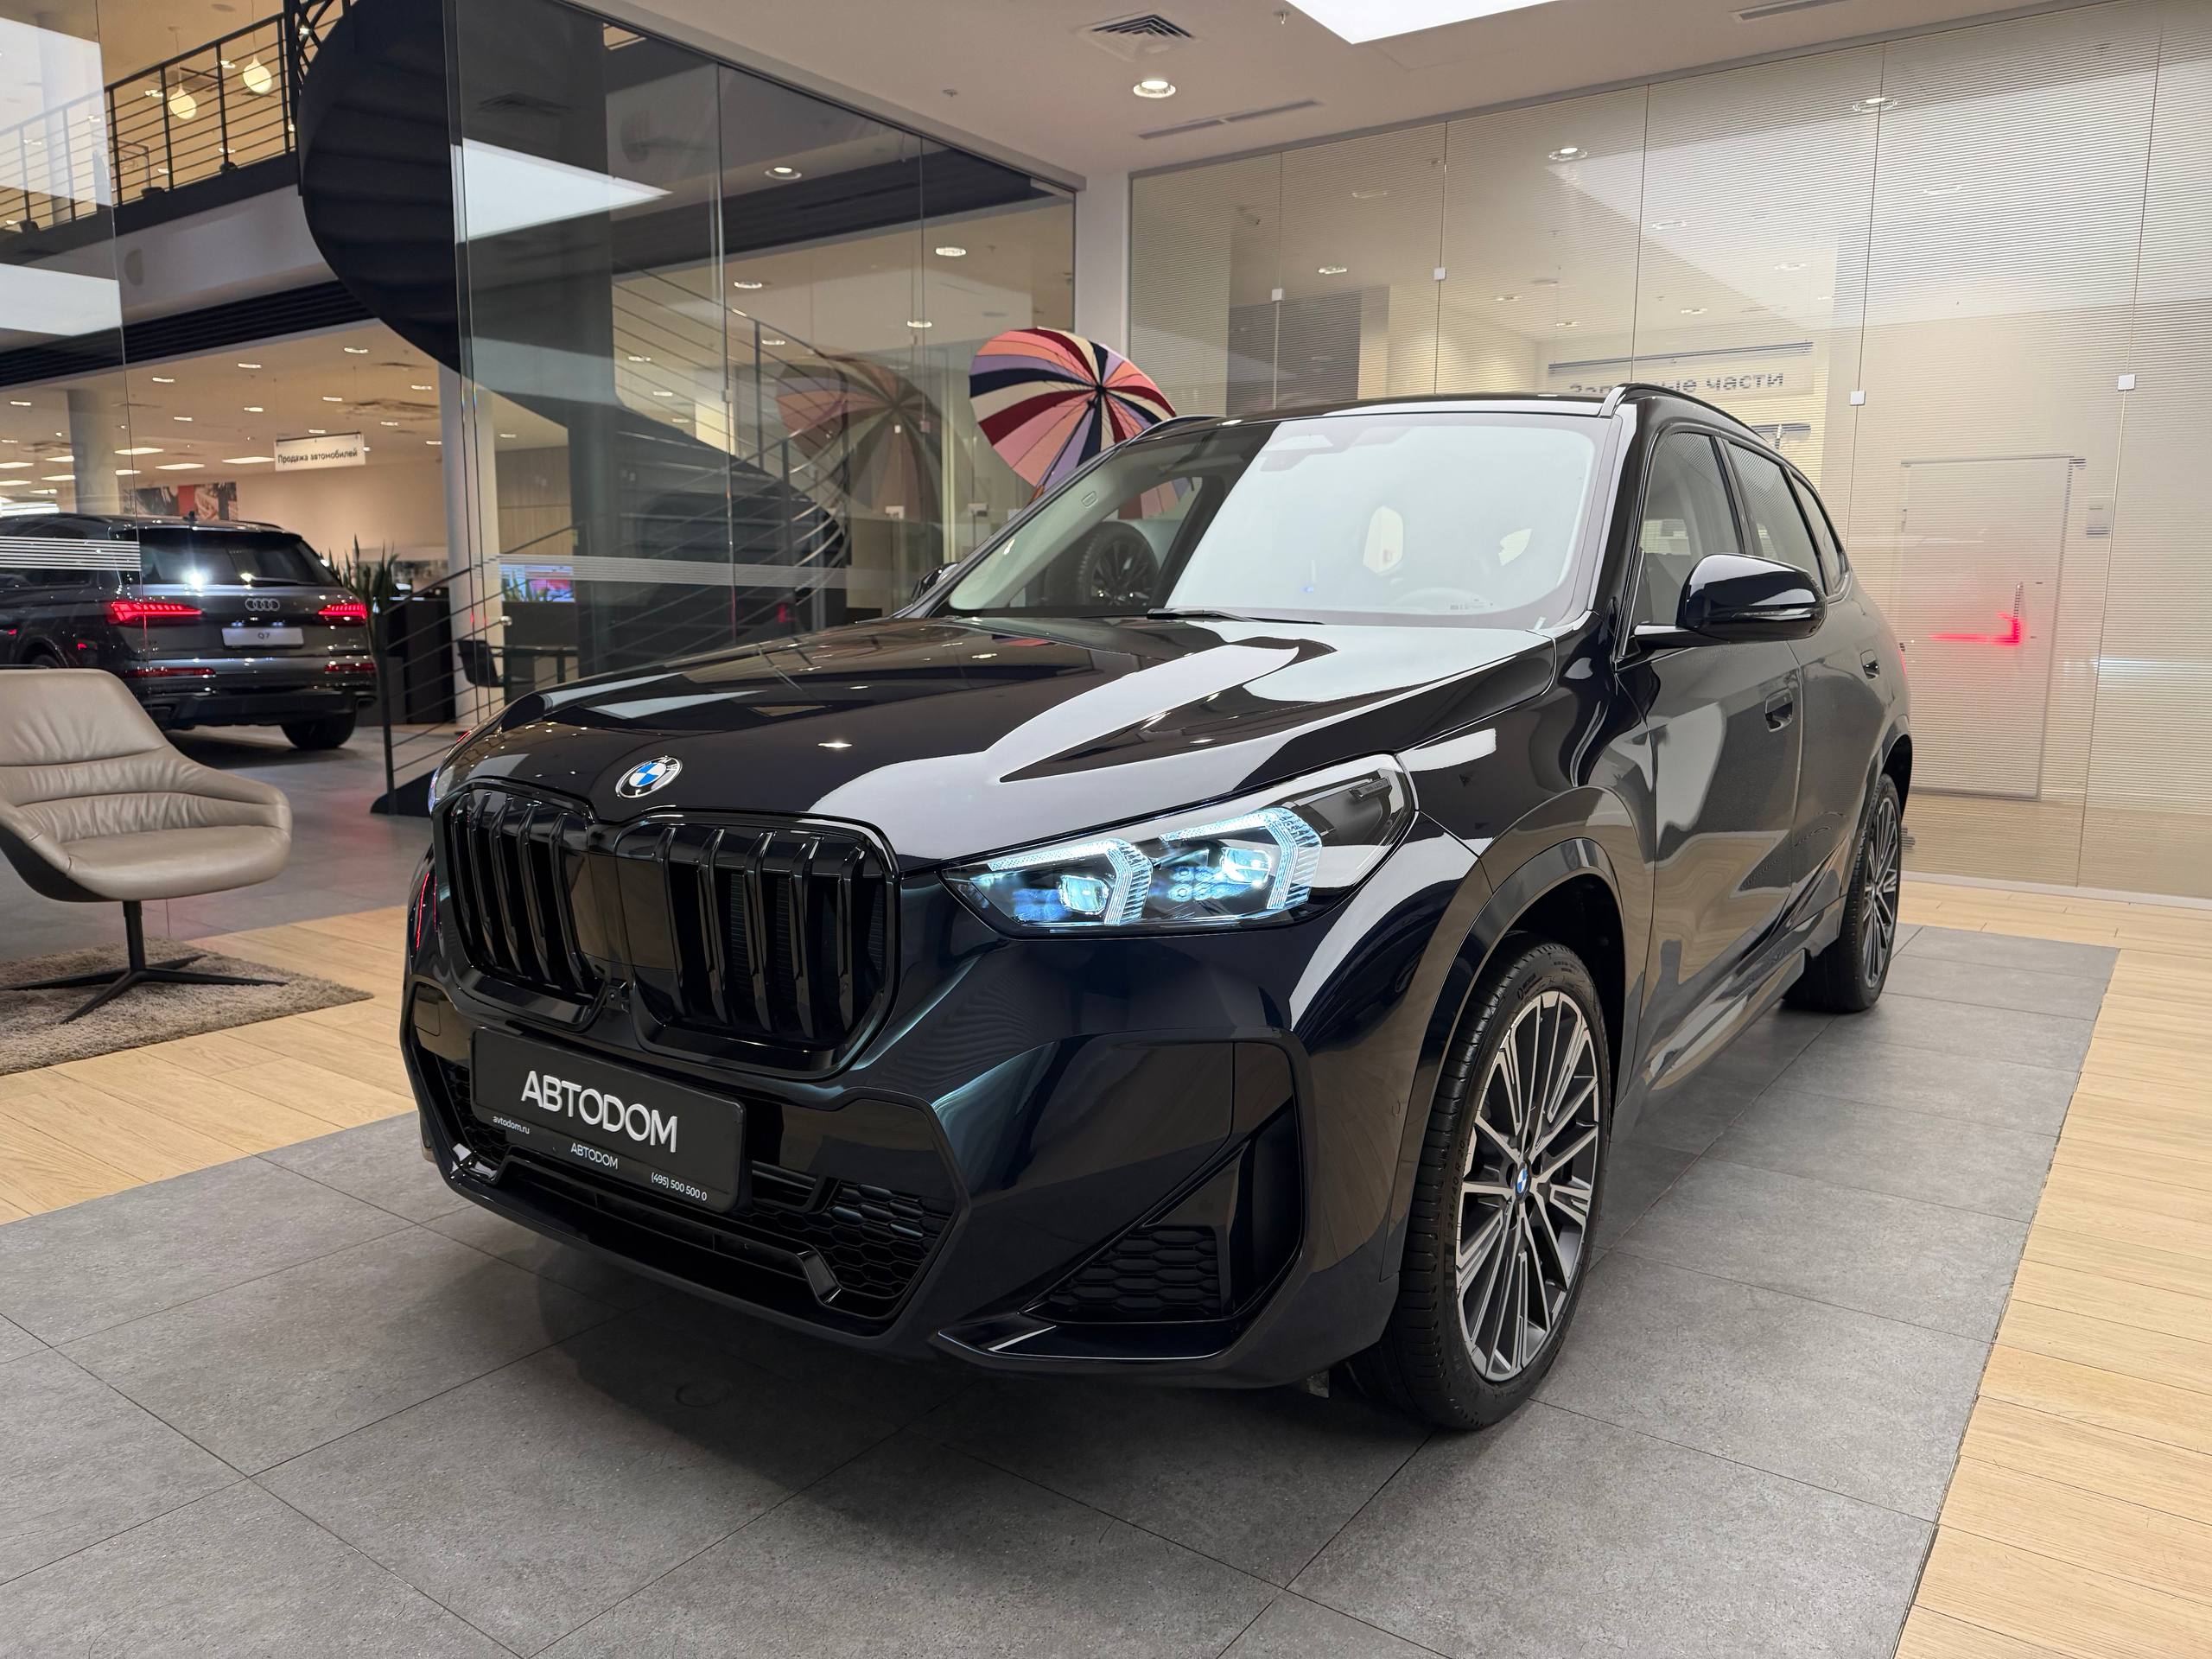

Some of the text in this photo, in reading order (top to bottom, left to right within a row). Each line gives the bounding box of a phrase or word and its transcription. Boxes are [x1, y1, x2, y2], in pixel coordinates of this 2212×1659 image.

[1707, 372, 1784, 391] части
[277, 448, 358, 465] Продажа автомобилей
[257, 632, 270, 640] Q7
[493, 1116, 531, 1134] avtodom.ru
[651, 1172, 708, 1201] (495) 500 500 0
